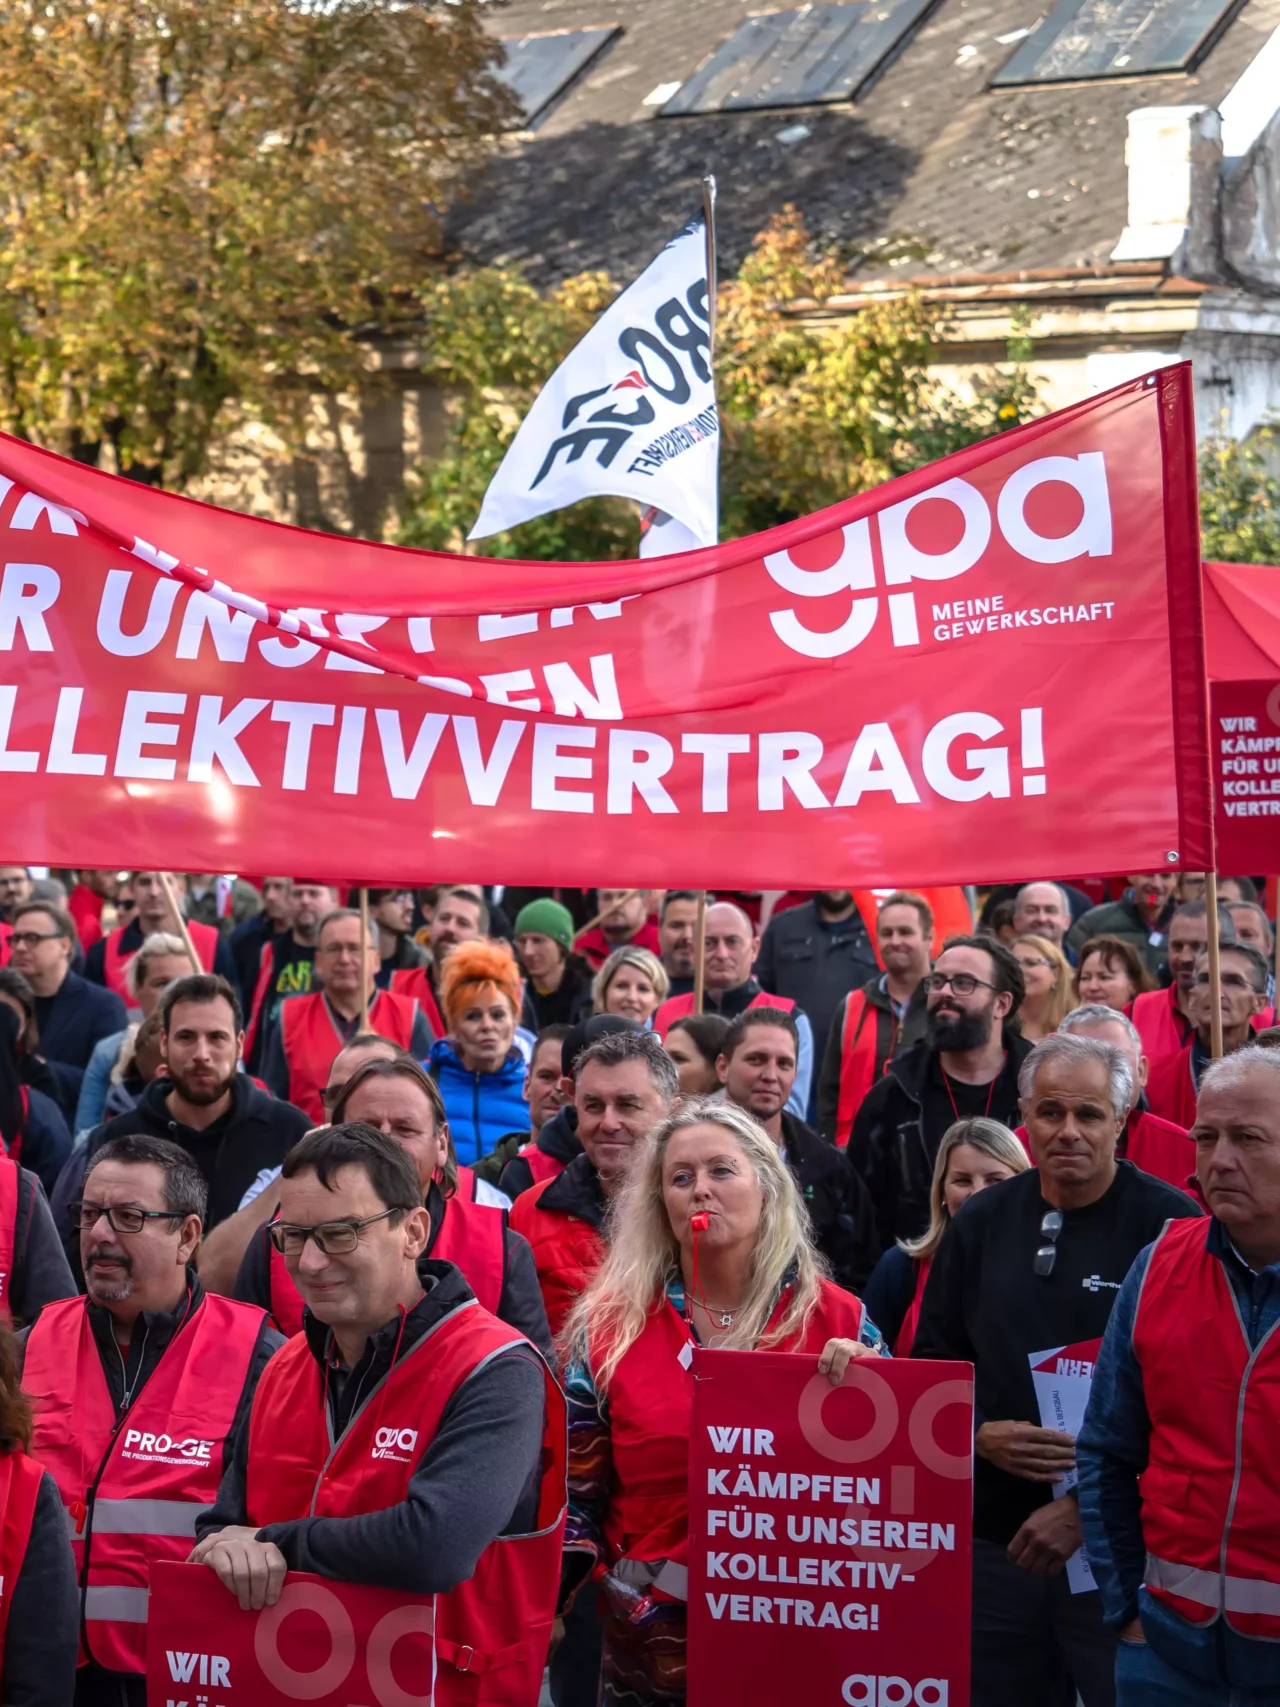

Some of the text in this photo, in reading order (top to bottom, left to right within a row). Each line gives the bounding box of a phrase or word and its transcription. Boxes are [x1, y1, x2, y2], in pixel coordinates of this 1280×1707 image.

[763, 451, 1113, 659] gpa
[932, 595, 1004, 622] MEINE
[933, 602, 1115, 641] GEWERKSCHAFT
[1220, 716, 1257, 732] WIR
[1222, 756, 1260, 775] FÜR
[1052, 1390, 1064, 1421] BERGBAU
[122, 1450, 132, 1459] DIE
[124, 1429, 215, 1459] PRO-GE
[707, 1426, 776, 1456] WIR
[707, 1463, 880, 1505] KÄMPFEN
[707, 1505, 955, 1551] FÜR UNSEREN
[706, 1551, 916, 1590] KOLLEKTIV-
[705, 1592, 880, 1631] VERTRAG!
[165, 1650, 232, 1688] WIR
